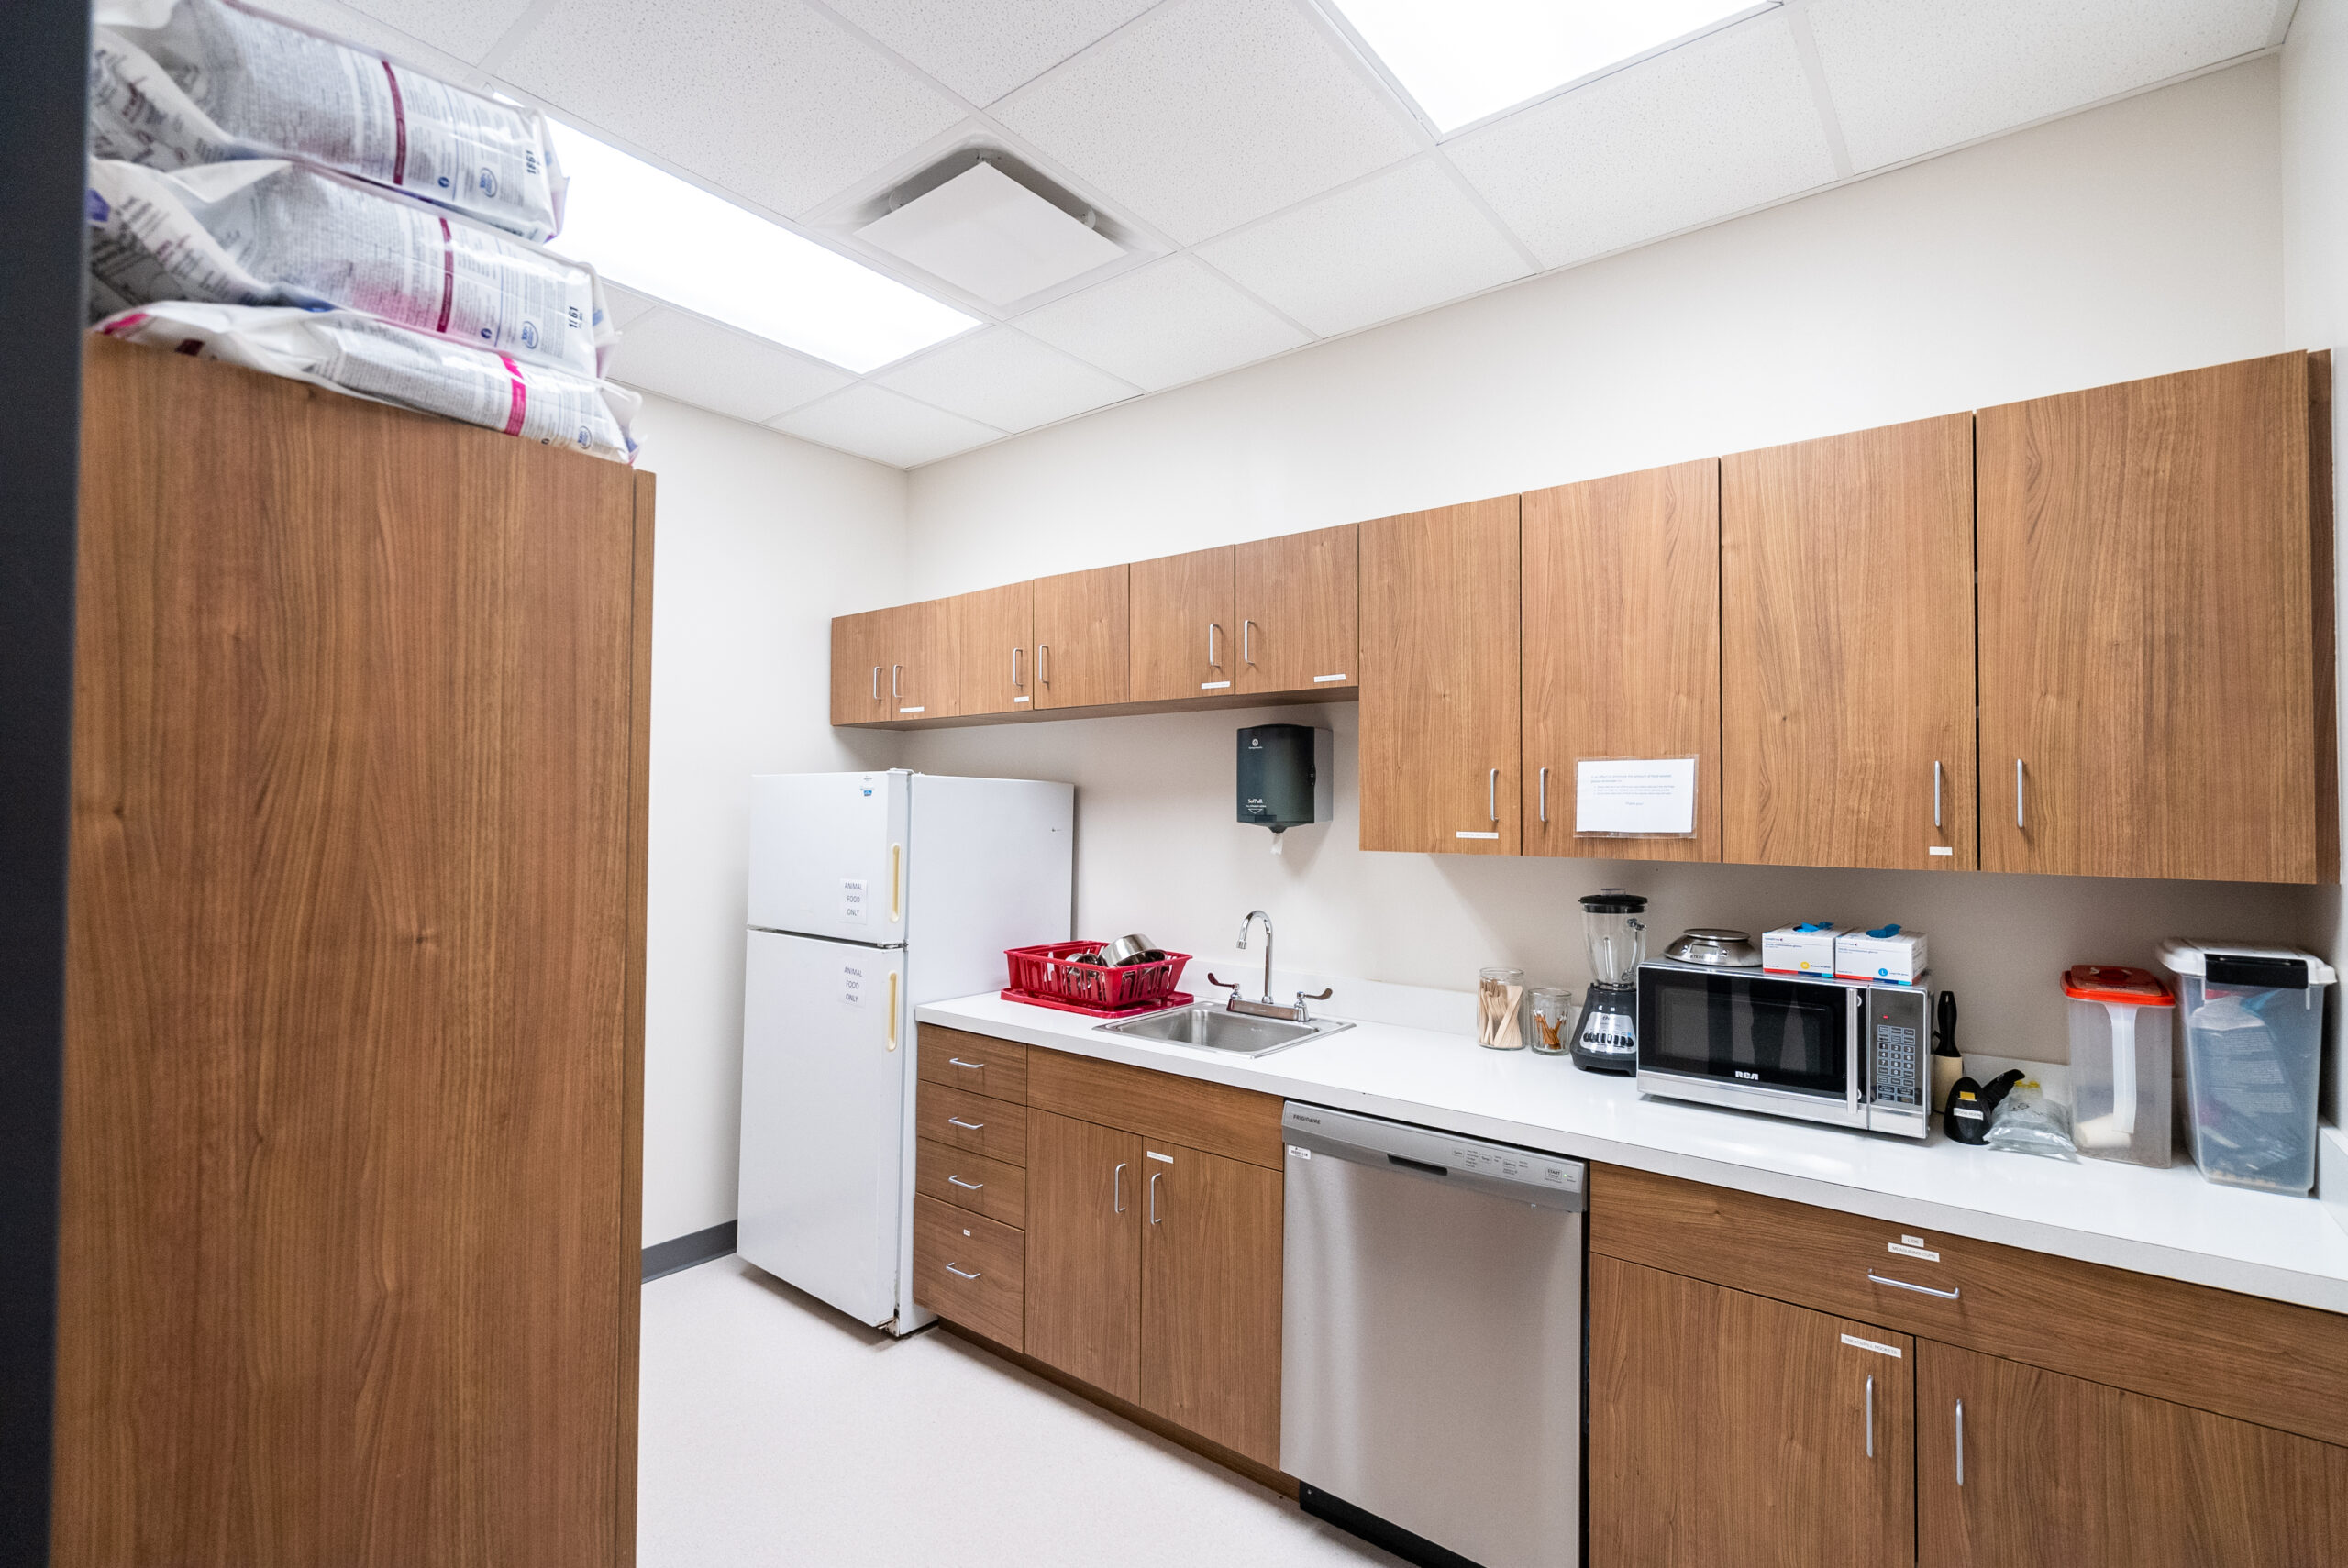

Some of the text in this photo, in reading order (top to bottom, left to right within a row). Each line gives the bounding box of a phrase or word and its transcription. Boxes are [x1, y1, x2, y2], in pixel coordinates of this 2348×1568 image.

[844, 881, 863, 890] ANIMAL
[847, 895, 861, 903] FOOD
[847, 908, 860, 917] ONLY
[844, 966, 863, 977] ANIMAL
[846, 979, 859, 989] FOOD
[845, 992, 858, 1003] ONLY
[1734, 1070, 1759, 1080] RCA
[1293, 1114, 1321, 1125] FRIGIDAIRE
[1892, 1246, 1922, 1255] MEASURING
